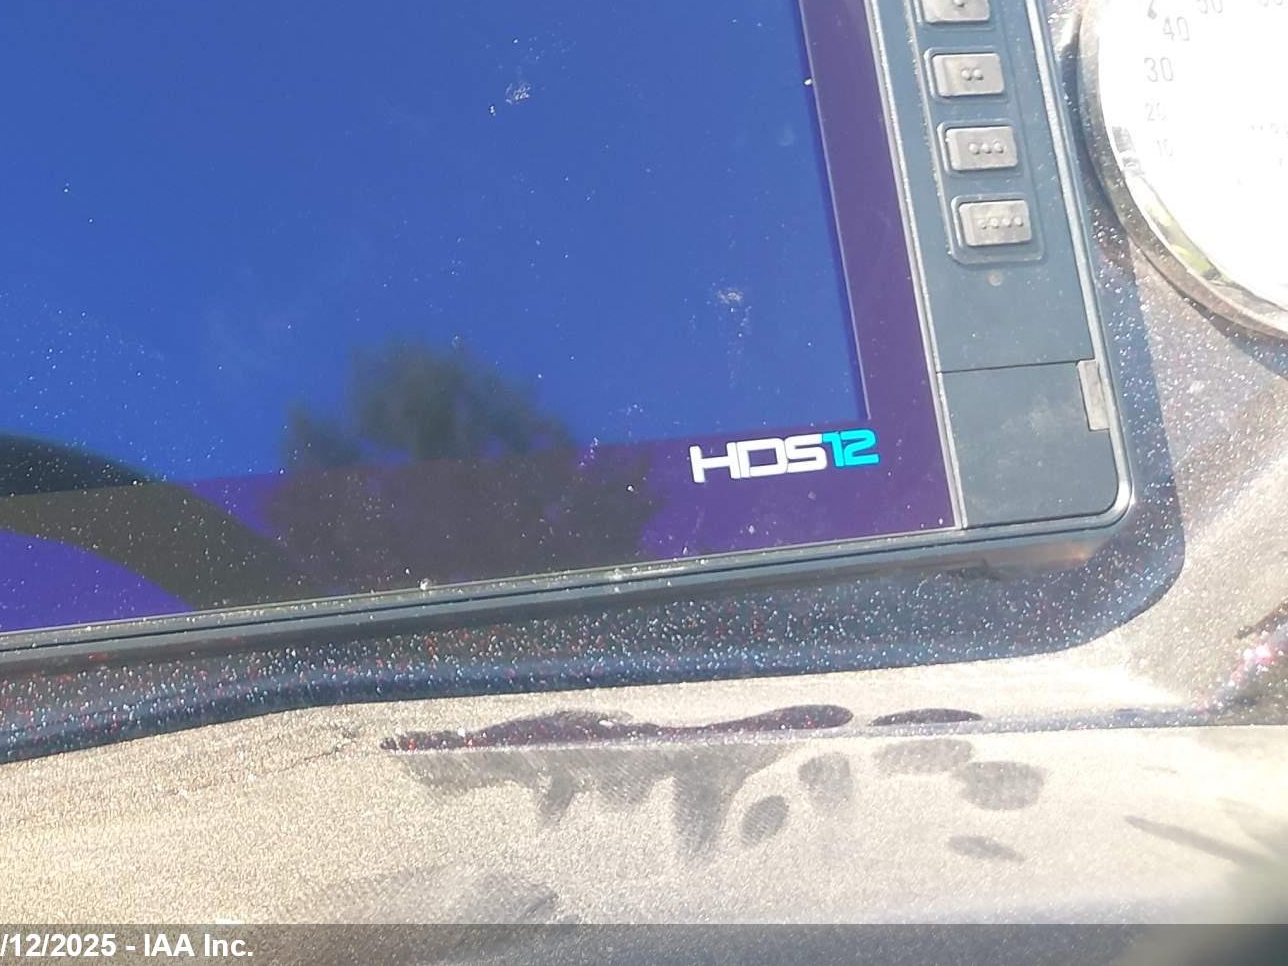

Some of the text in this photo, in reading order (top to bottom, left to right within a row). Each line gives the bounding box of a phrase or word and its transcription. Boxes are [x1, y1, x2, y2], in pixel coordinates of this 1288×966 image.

[1163, 16, 1190, 41] 40
[1144, 56, 1175, 82] 30
[689, 429, 880, 483] HDS12
